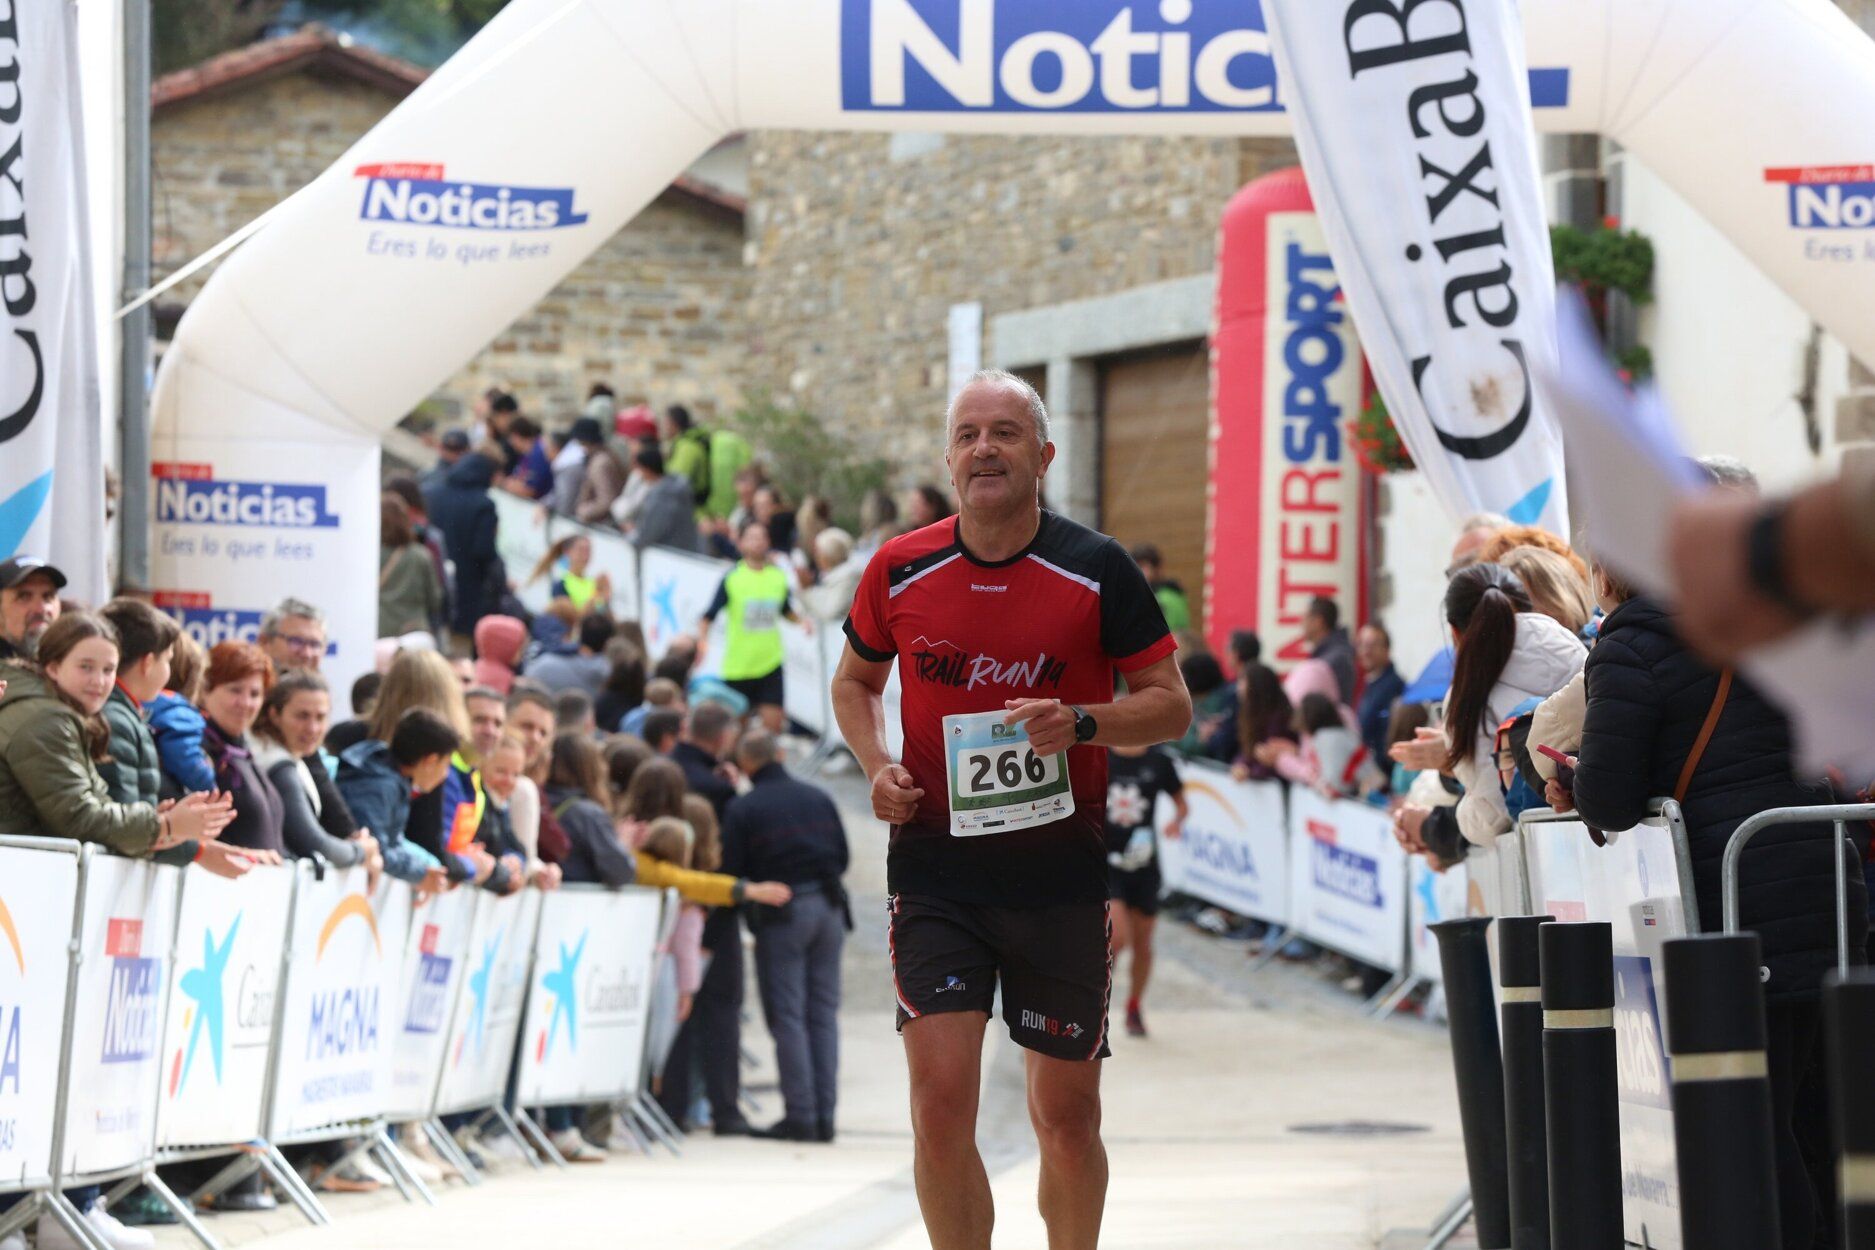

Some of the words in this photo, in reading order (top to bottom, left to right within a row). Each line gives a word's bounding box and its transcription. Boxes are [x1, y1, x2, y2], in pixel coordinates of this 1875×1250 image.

[870, 0, 1284, 108] Notic
[366, 180, 559, 228] Noticias
[1795, 184, 1875, 226] No
[365, 230, 417, 255] Eres
[425, 236, 447, 258] lo
[455, 242, 500, 266] que
[507, 239, 551, 259] lees
[160, 479, 318, 526] Noticias
[226, 538, 264, 562] que
[970, 747, 1045, 792] 266
[305, 986, 379, 1061] MAGNA
